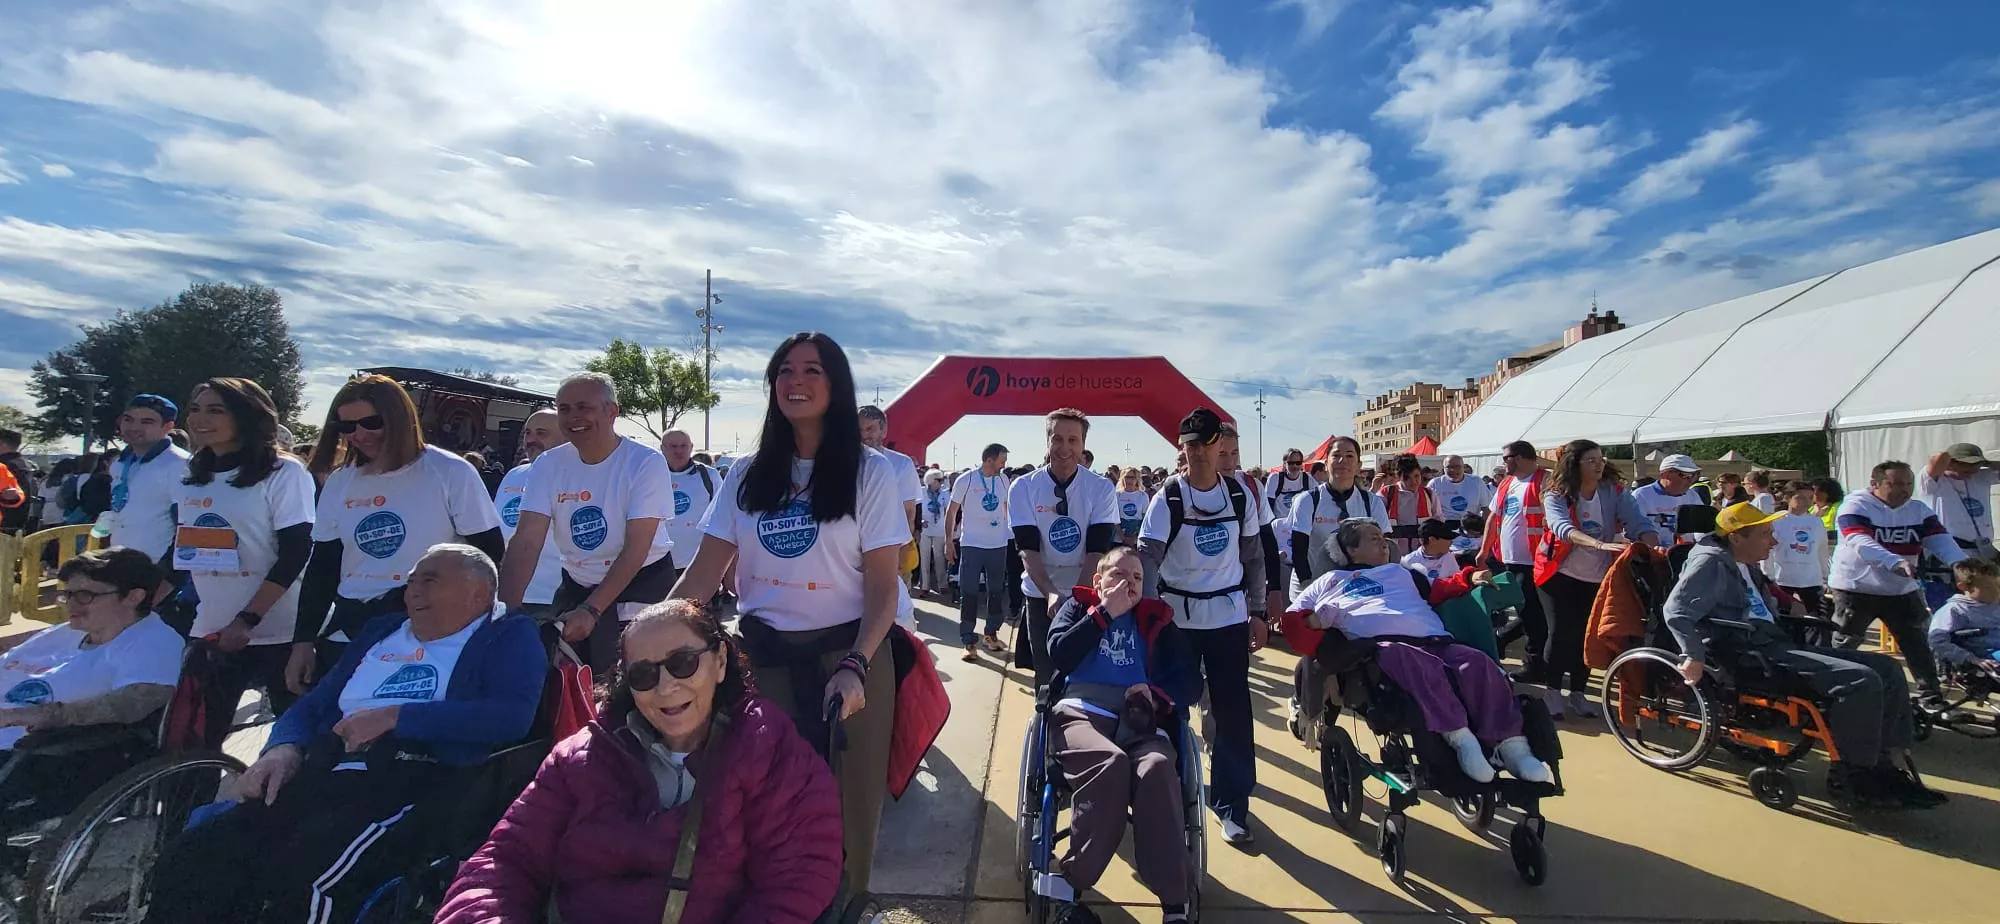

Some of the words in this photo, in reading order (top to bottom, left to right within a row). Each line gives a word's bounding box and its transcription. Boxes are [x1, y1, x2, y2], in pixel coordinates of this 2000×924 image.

[1006, 373, 1050, 392] hoya
[1055, 374, 1076, 389] de
[1081, 374, 1143, 389] huesca
